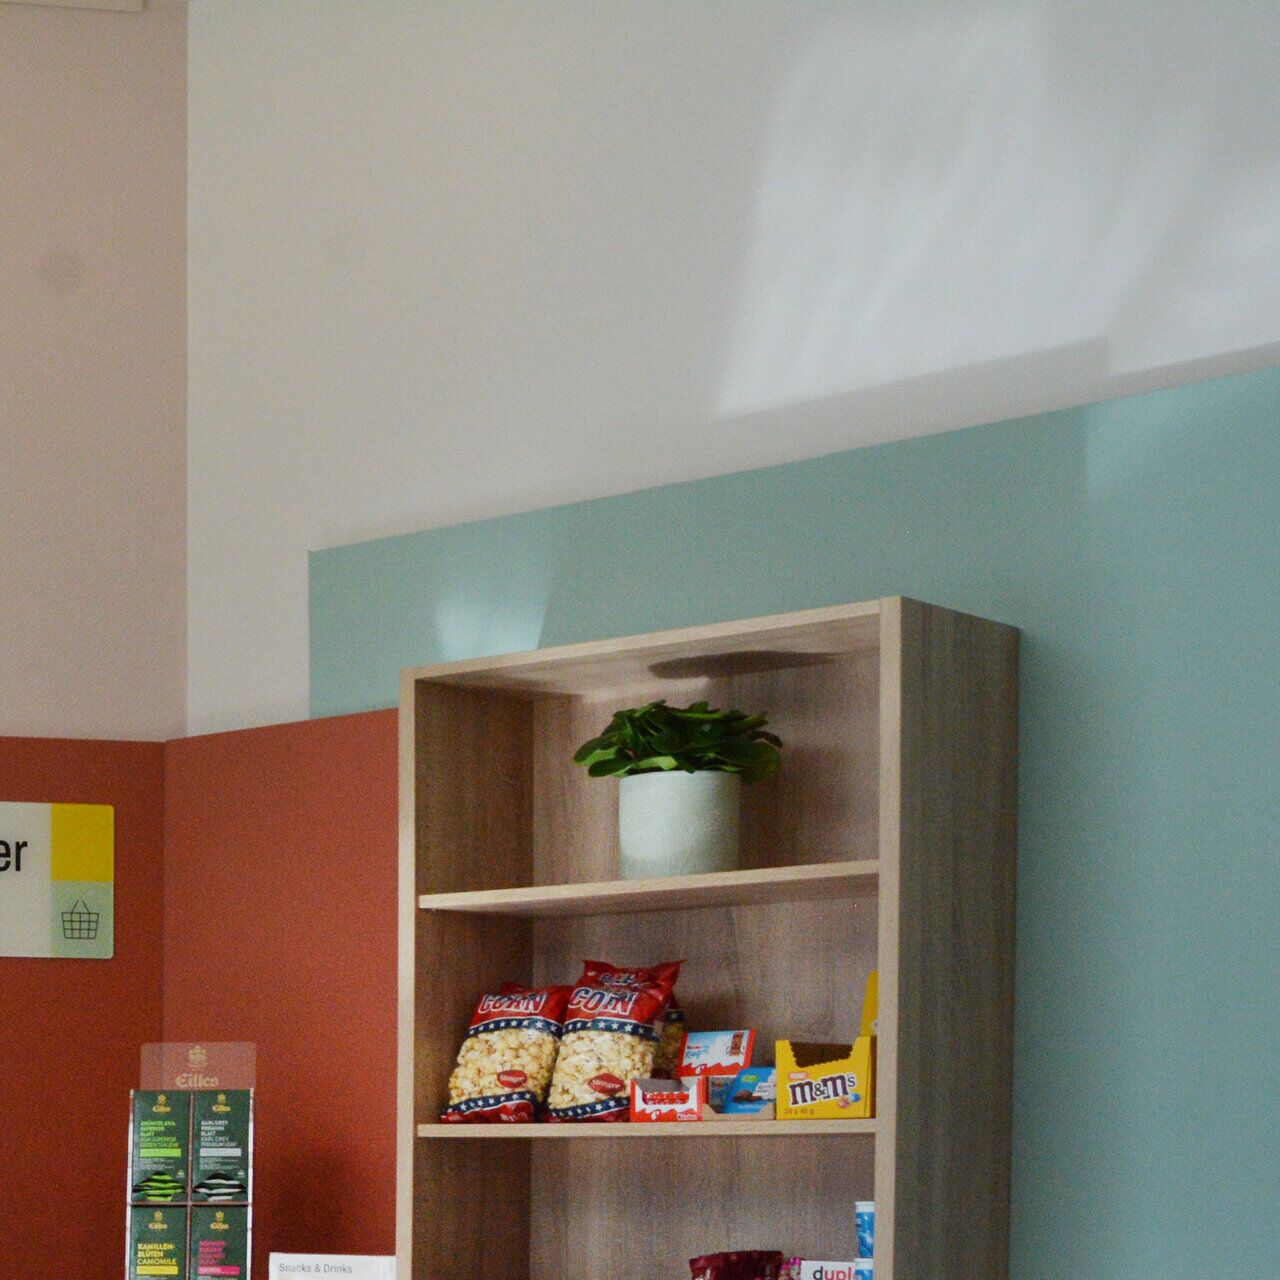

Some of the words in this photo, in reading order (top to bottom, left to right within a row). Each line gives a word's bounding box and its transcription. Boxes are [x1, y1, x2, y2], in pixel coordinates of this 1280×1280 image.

[279, 1263, 312, 1273] Snacks
[314, 1263, 321, 1273] &
[323, 1264, 353, 1274] Drinks
